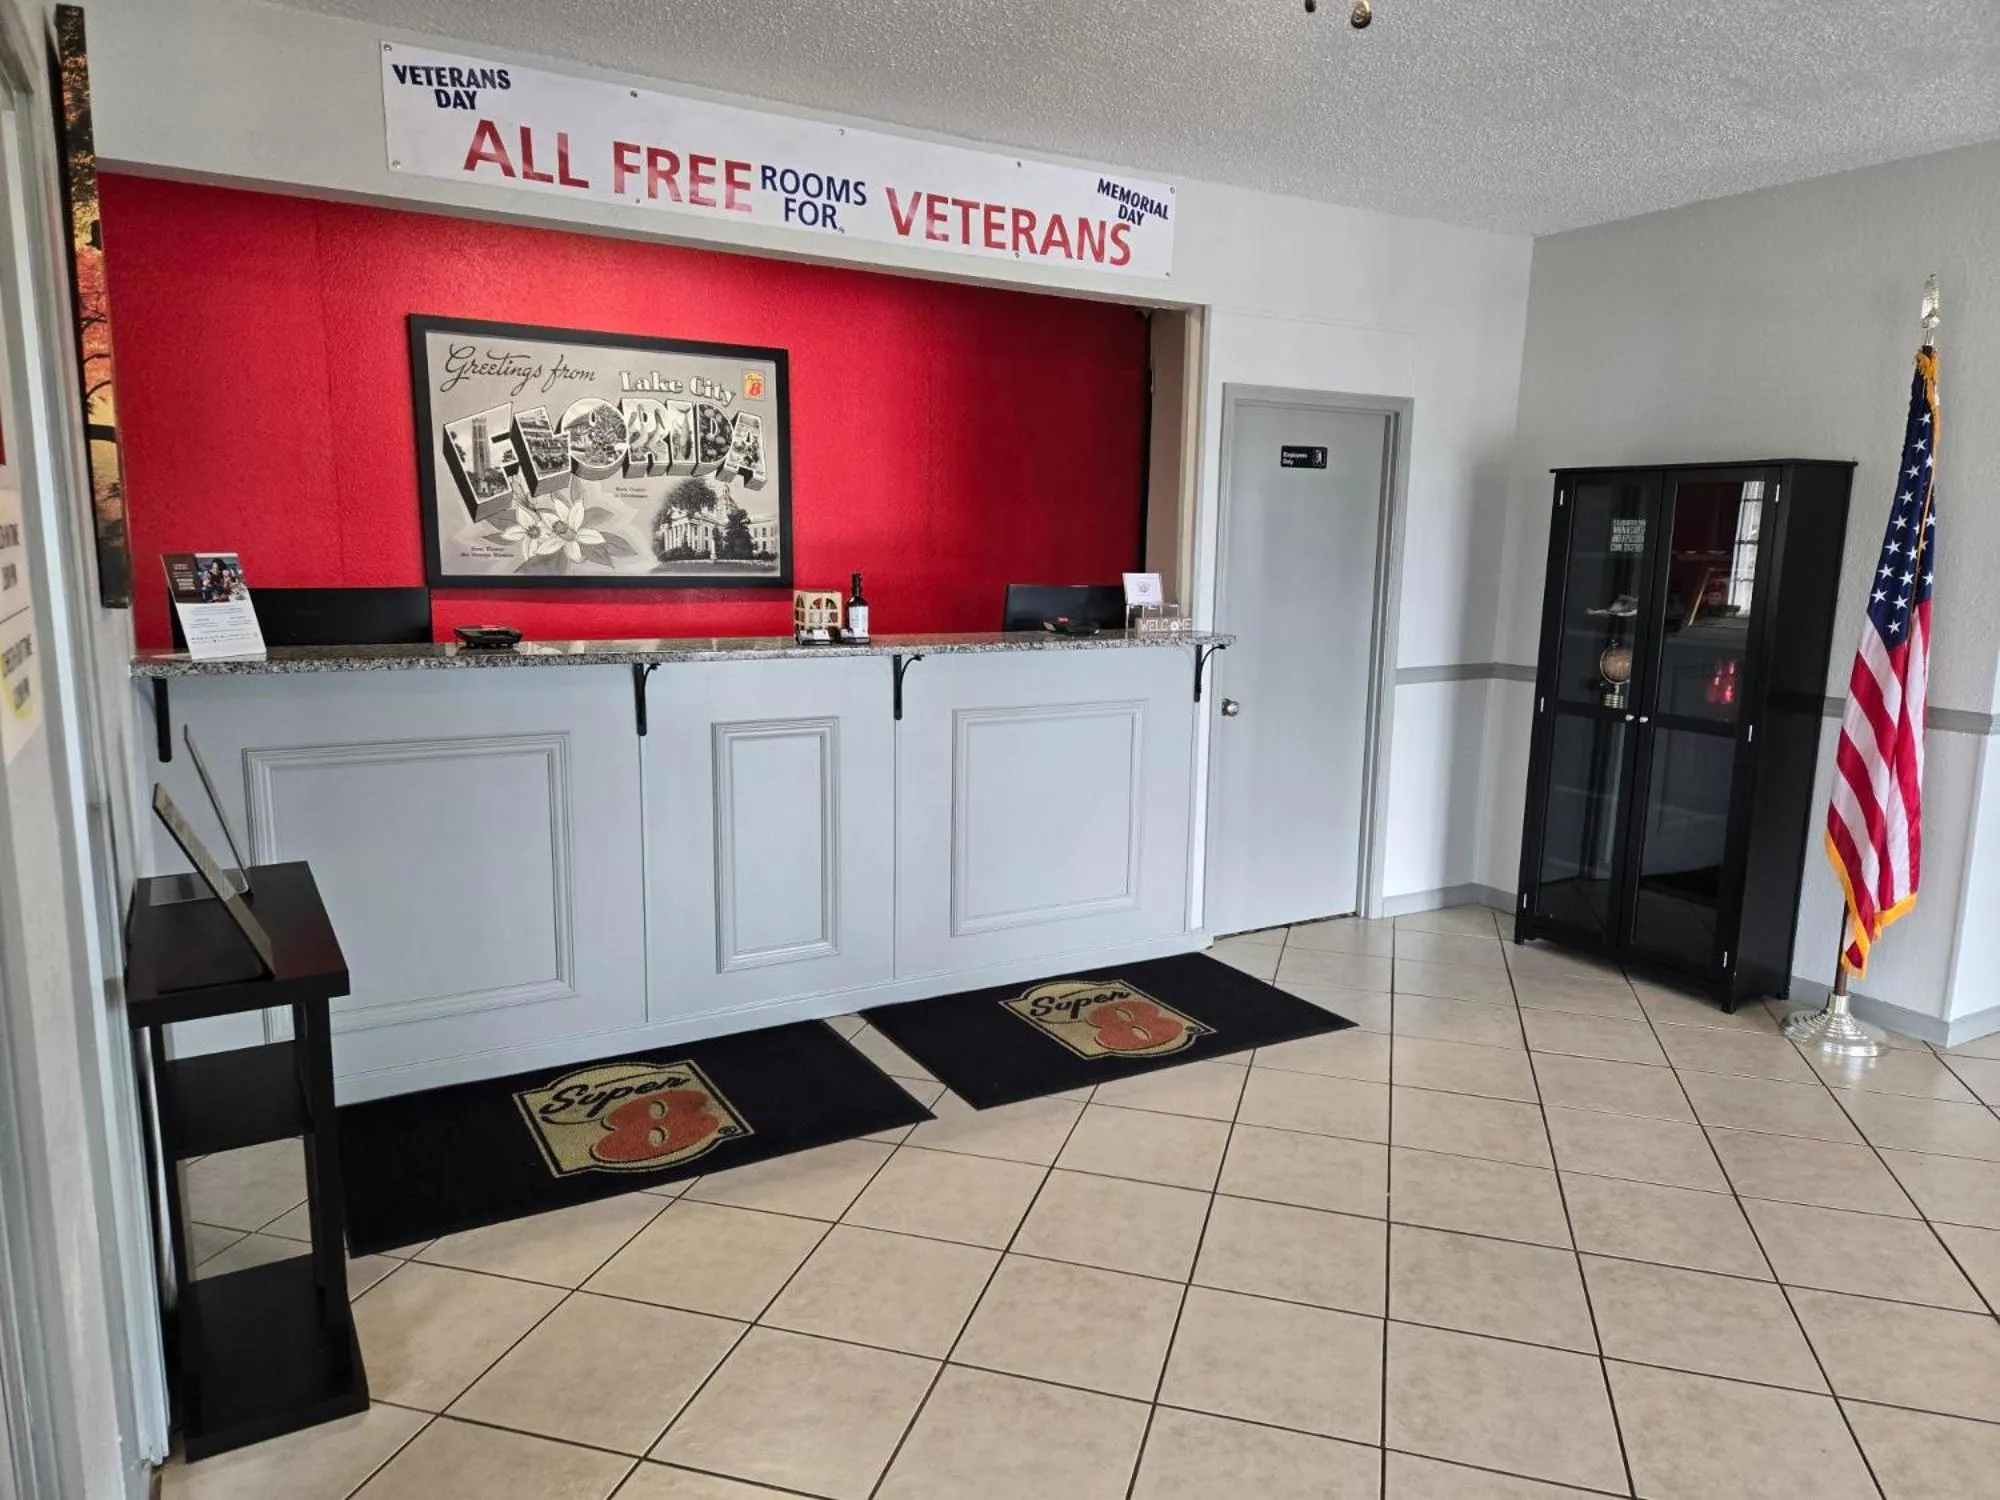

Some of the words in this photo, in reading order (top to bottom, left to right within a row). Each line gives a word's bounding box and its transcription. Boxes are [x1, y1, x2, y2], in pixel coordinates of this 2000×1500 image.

[391, 63, 511, 91] VETERANS
[434, 88, 478, 111] DAY
[463, 118, 590, 189] ALL
[612, 140, 753, 213] FREE
[760, 164, 867, 206] ROOMS
[783, 197, 838, 230] FOR
[1096, 177, 1170, 221] MEMORIAL
[1117, 203, 1145, 227] DAY
[885, 186, 1132, 267] VETERANS
[440, 344, 544, 397] Greetings
[541, 353, 596, 394] from
[619, 370, 684, 395] Lake
[688, 375, 737, 408] City
[443, 399, 768, 523] FLORIDA
[1140, 617, 1192, 632] WELCOME
[1030, 990, 1132, 1020] Super
[538, 1075, 693, 1119] Super
